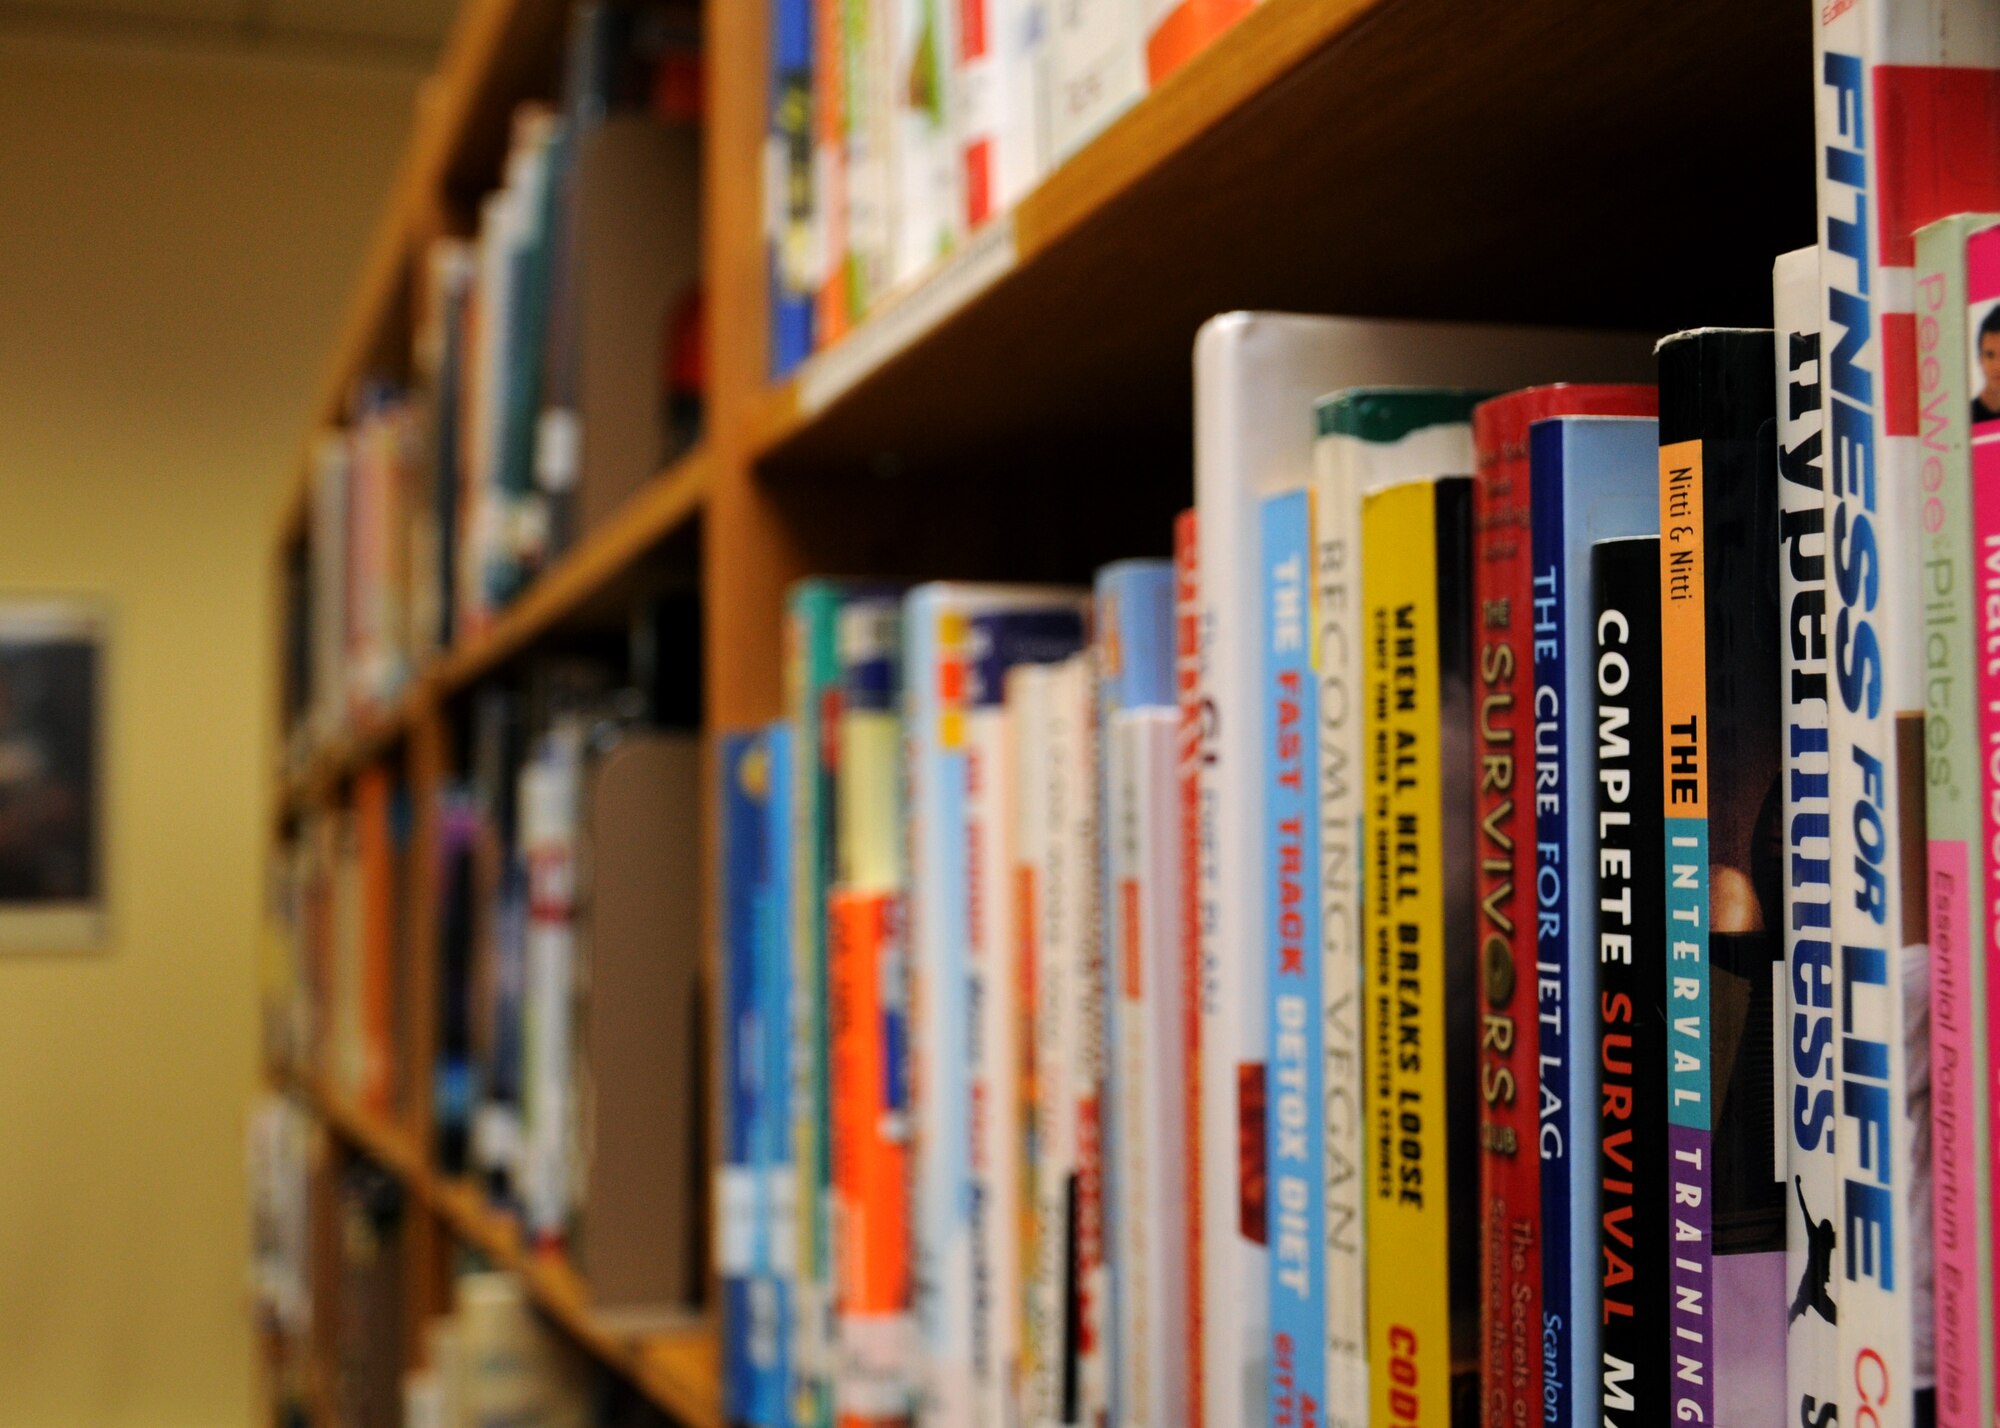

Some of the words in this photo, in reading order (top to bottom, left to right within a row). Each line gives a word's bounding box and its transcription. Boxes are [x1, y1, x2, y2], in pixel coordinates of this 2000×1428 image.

[1824, 51, 1883, 720] FITNESS
[1916, 272, 1949, 535] PeeWee
[1668, 467, 1692, 517] Nitti
[1669, 525, 1693, 543] &
[1273, 553, 1301, 655] THE
[1532, 565, 1556, 664] THE
[1669, 551, 1694, 601] Nitti
[1394, 604, 1415, 711] WHEN
[1275, 669, 1303, 793] FAST
[1320, 538, 1350, 952] BECOMING
[1395, 731, 1416, 793] ALL
[1534, 684, 1559, 818] CURE
[1597, 608, 1632, 965] COMPLETE
[1670, 714, 1697, 805] THE
[1277, 815, 1305, 979] TRACK
[1395, 814, 1418, 900] HELL
[1480, 643, 1514, 1104] SURVIVORS
[1536, 842, 1560, 941] FOR
[1851, 743, 1887, 927] FOR
[1397, 923, 1420, 1072] BREAKS
[1535, 961, 1561, 1036] JET
[1670, 836, 1700, 1107] INTERVAL
[1933, 871, 1957, 1031] Essential
[1276, 995, 1308, 1162] DETOX
[1325, 993, 1356, 1256] VEGAN
[1538, 1054, 1562, 1162] LAG
[1840, 945, 1894, 1293] LIFE
[1398, 1090, 1422, 1208] LOOSE
[1600, 990, 1633, 1325] SURVIVAL
[1935, 1040, 1961, 1251] Postpartum
[1278, 1175, 1309, 1298] DIET
[1510, 1220, 1533, 1272] The
[1674, 1147, 1702, 1423] TRAINING
[1387, 1324, 1419, 1428] COD
[1510, 1281, 1532, 1388] Secrets
[1542, 1310, 1563, 1423] Scanlon
[1939, 1263, 1964, 1414] Exercise
